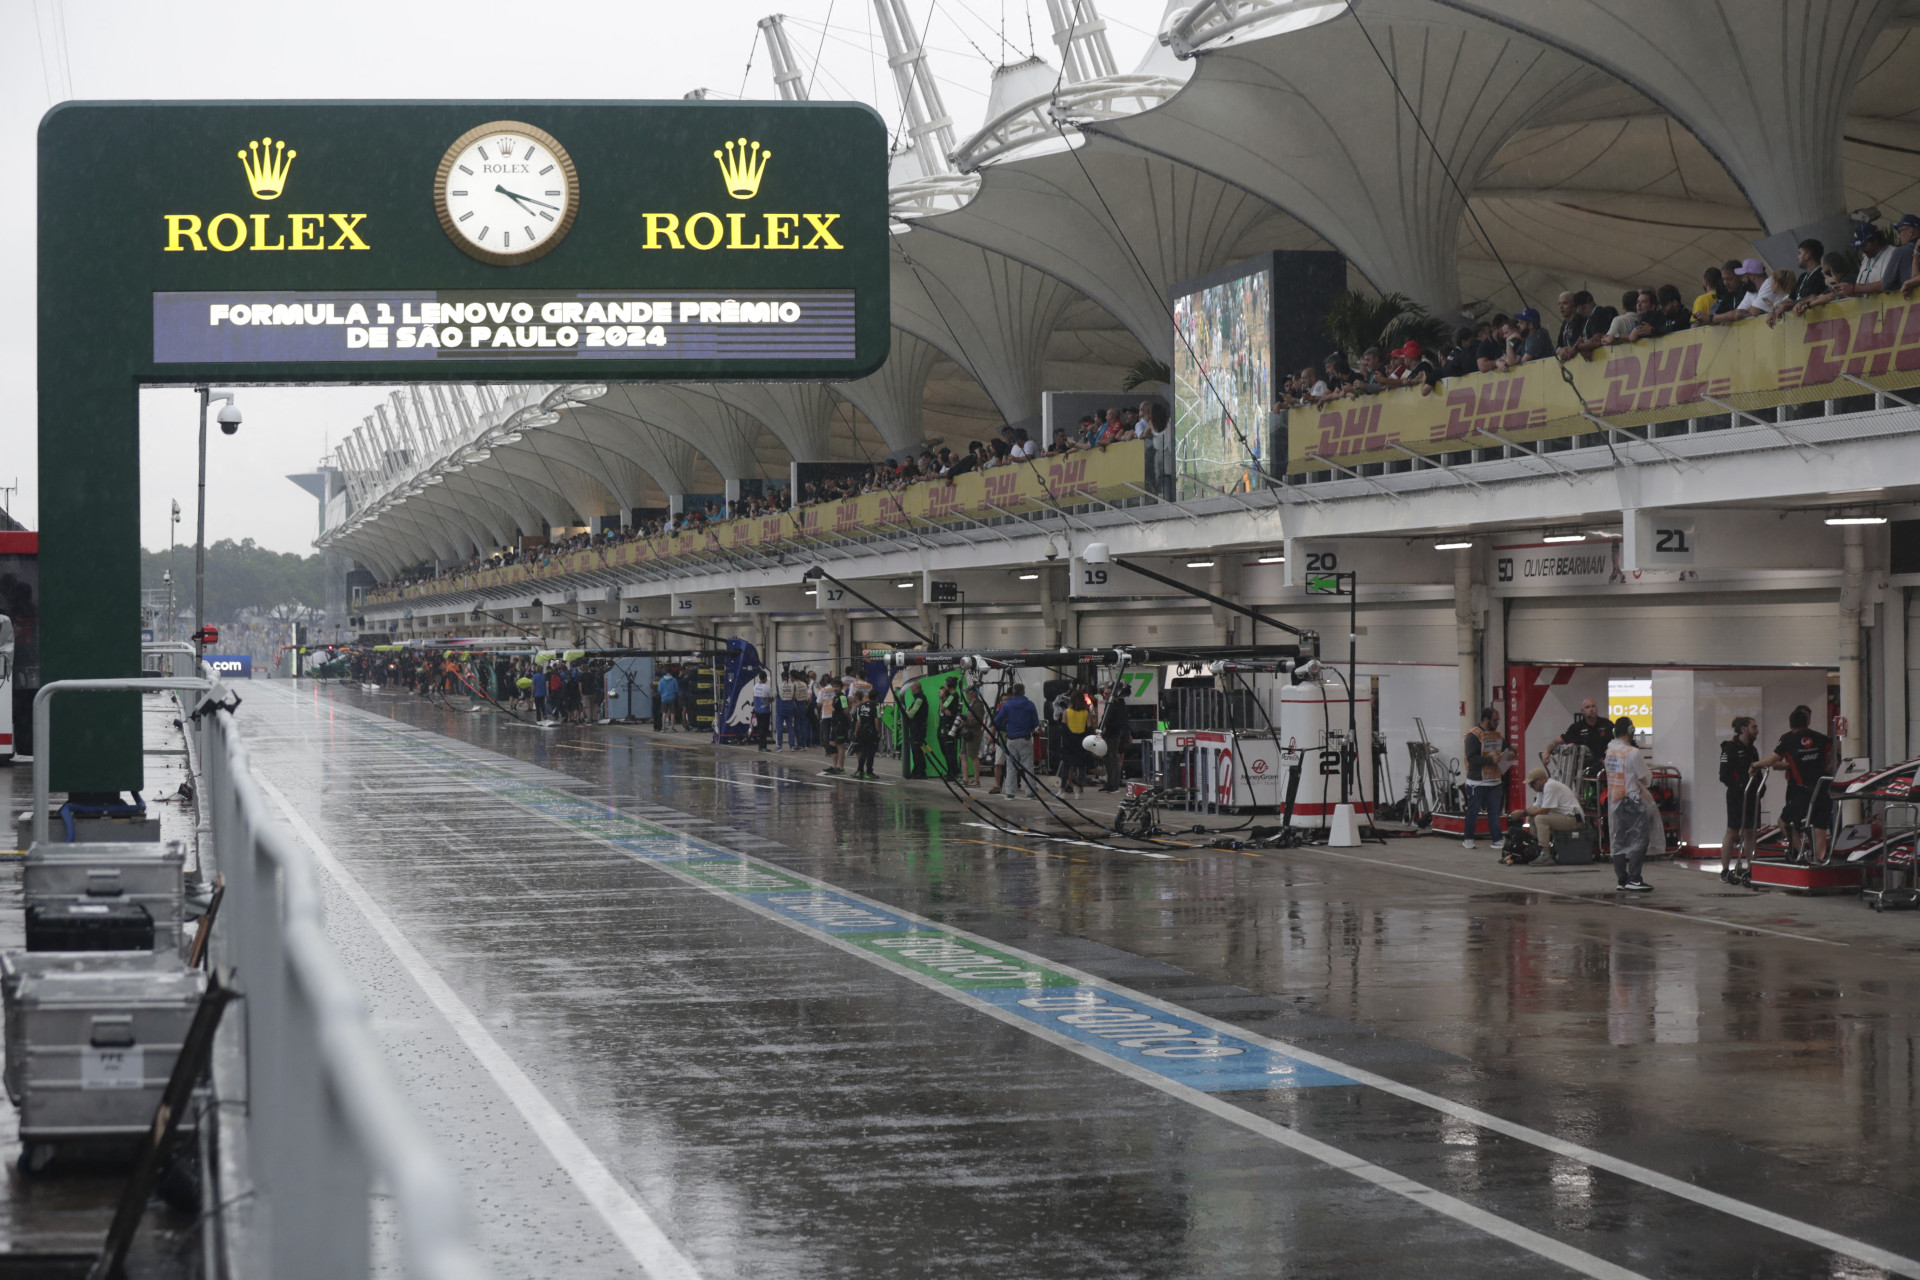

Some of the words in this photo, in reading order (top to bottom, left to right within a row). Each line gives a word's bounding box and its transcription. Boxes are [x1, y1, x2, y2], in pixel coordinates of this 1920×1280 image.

[483, 164, 530, 173] ROLEX
[163, 213, 370, 251] ROLEX
[641, 212, 844, 250] ROLEX
[209, 303, 369, 325] FORMULA
[377, 303, 395, 324] 1
[402, 302, 535, 324] LENOVO
[541, 302, 672, 323] GRANDE
[679, 299, 801, 323] PRÊMIO
[347, 327, 389, 348] DE
[396, 324, 463, 348] SÃO
[470, 326, 579, 347] PAULO
[586, 325, 667, 347] 2024
[1604, 343, 1709, 416] DHL
[1446, 377, 1531, 440] DHL
[1317, 404, 1387, 458] DHL
[984, 473, 1021, 509] DHL
[1049, 459, 1090, 499] DHL
[879, 495, 905, 523] DHL
[928, 484, 959, 519] DHL
[836, 503, 859, 532] DHL
[1656, 529, 1690, 553] 21
[1306, 552, 1337, 571] 20
[1499, 557, 1514, 582] 50
[1524, 558, 1556, 577] OLIVER
[1555, 555, 1606, 576] BEARMAN
[1084, 570, 1108, 585] 19
[678, 600, 693, 609] 15
[745, 595, 760, 606] 16
[827, 589, 844, 601] 17
[585, 607, 597, 615] 13
[626, 605, 639, 614] 14
[209, 661, 241, 671] .com
